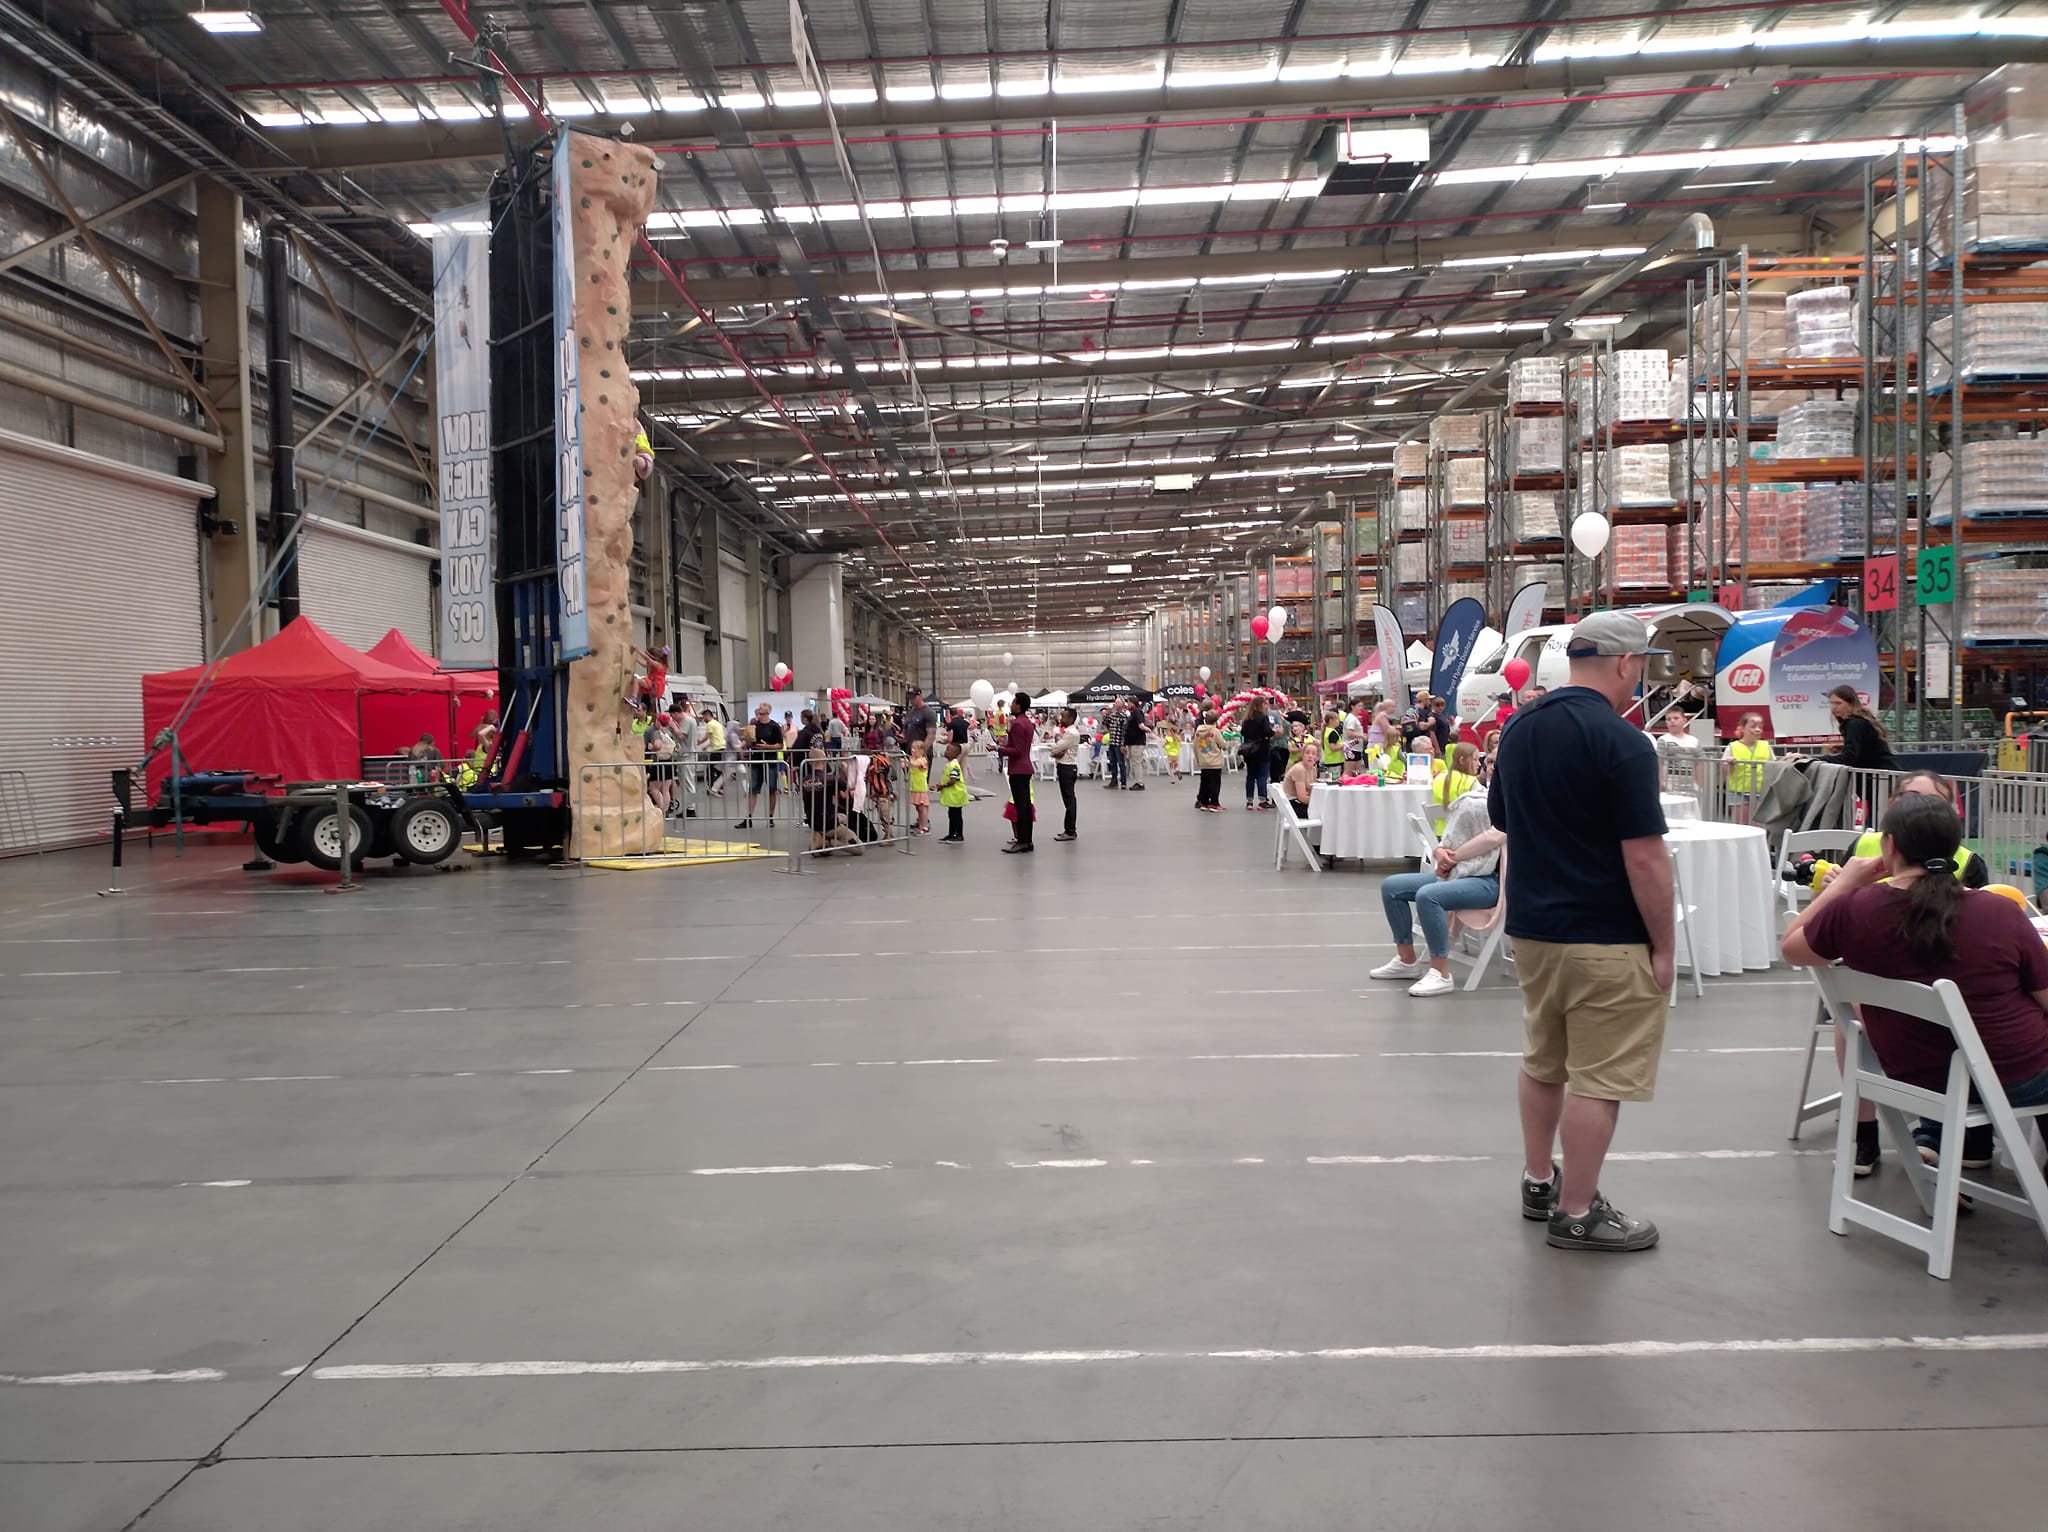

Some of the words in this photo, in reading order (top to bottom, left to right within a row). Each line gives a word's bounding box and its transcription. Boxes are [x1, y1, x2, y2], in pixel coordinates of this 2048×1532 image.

[1920, 556, 1951, 595] 35
[1868, 565, 1895, 601] 34
[1446, 679, 1457, 696] Royal
[1453, 661, 1465, 680] Flying
[1460, 640, 1473, 661] Doctor
[1468, 619, 1481, 641] Service
[1781, 663, 1829, 672] Aeromedical
[1830, 662, 1861, 673] Training
[1731, 669, 1762, 687] IGA
[1787, 672, 1826, 681] Education
[1827, 671, 1862, 681] Simulator
[1090, 684, 1131, 692] coles
[1167, 686, 1194, 695] coles
[1086, 694, 1116, 702] Hydration
[1776, 694, 1809, 702] ISUZU
